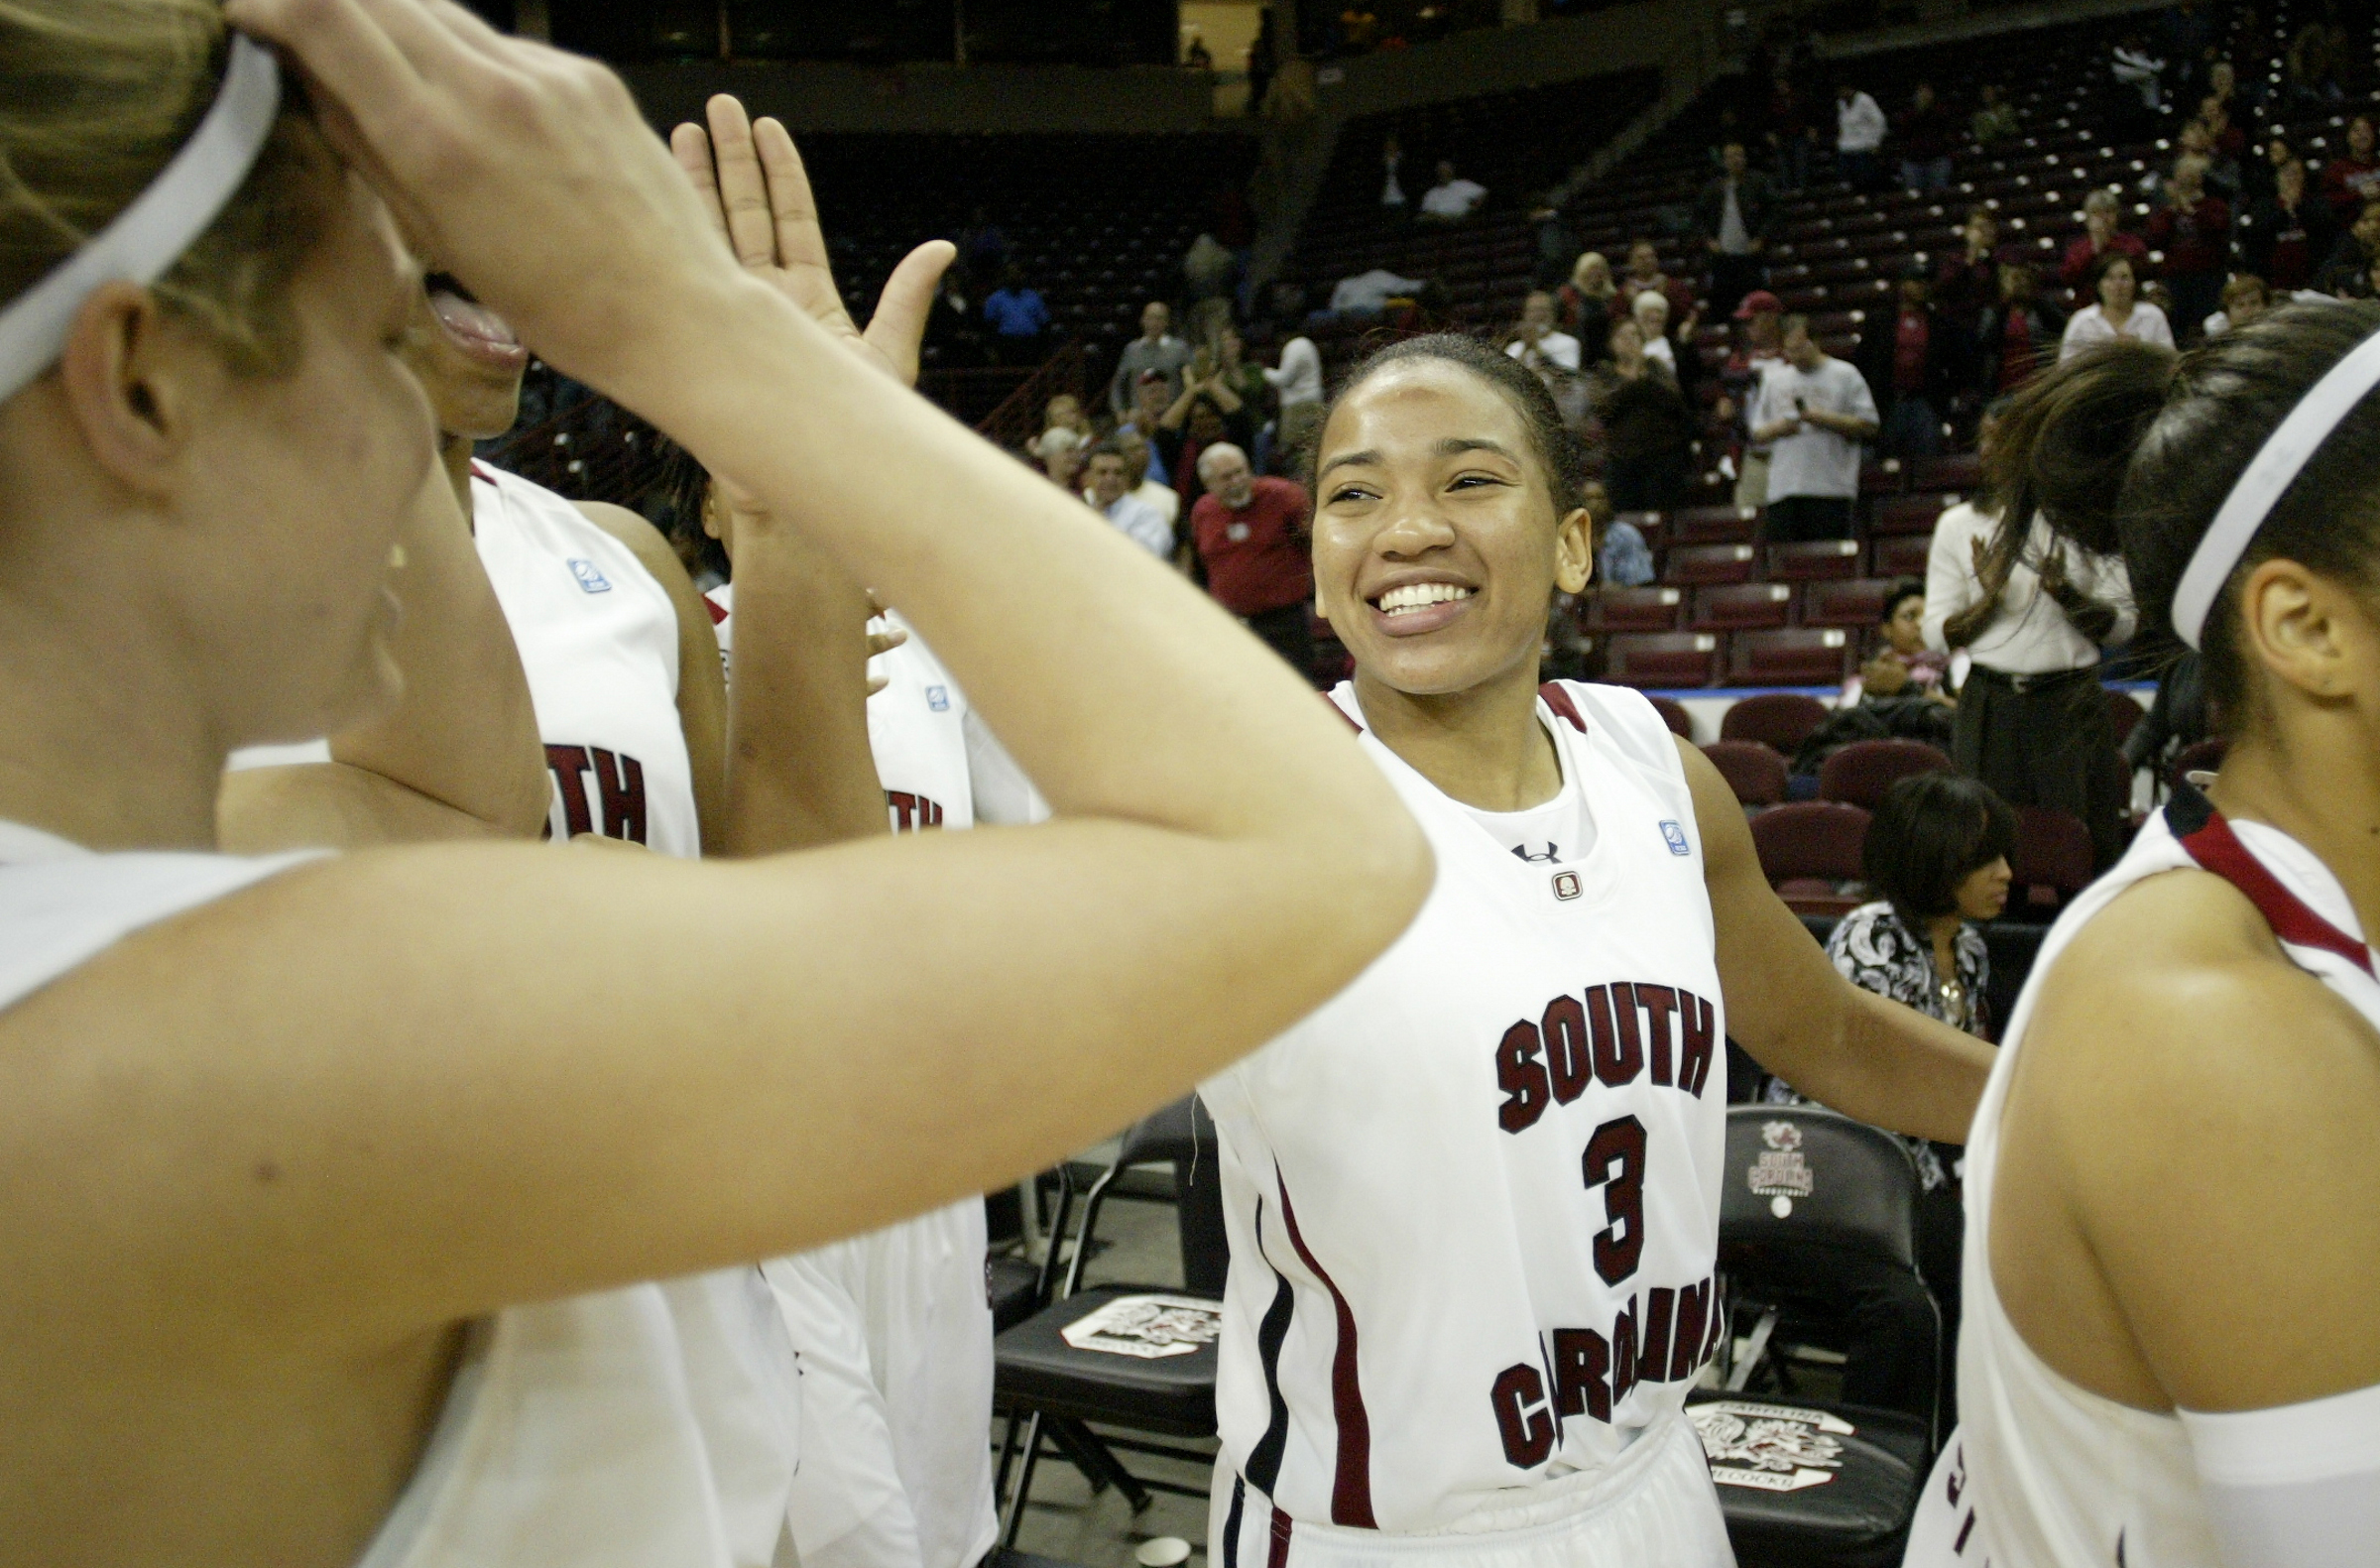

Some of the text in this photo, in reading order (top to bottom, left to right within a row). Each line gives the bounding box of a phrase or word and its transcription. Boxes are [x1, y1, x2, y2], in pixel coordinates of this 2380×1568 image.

[541, 743, 647, 846] TH
[1495, 981, 1716, 1136] SOUTH
[1582, 1114, 1648, 1288] 3
